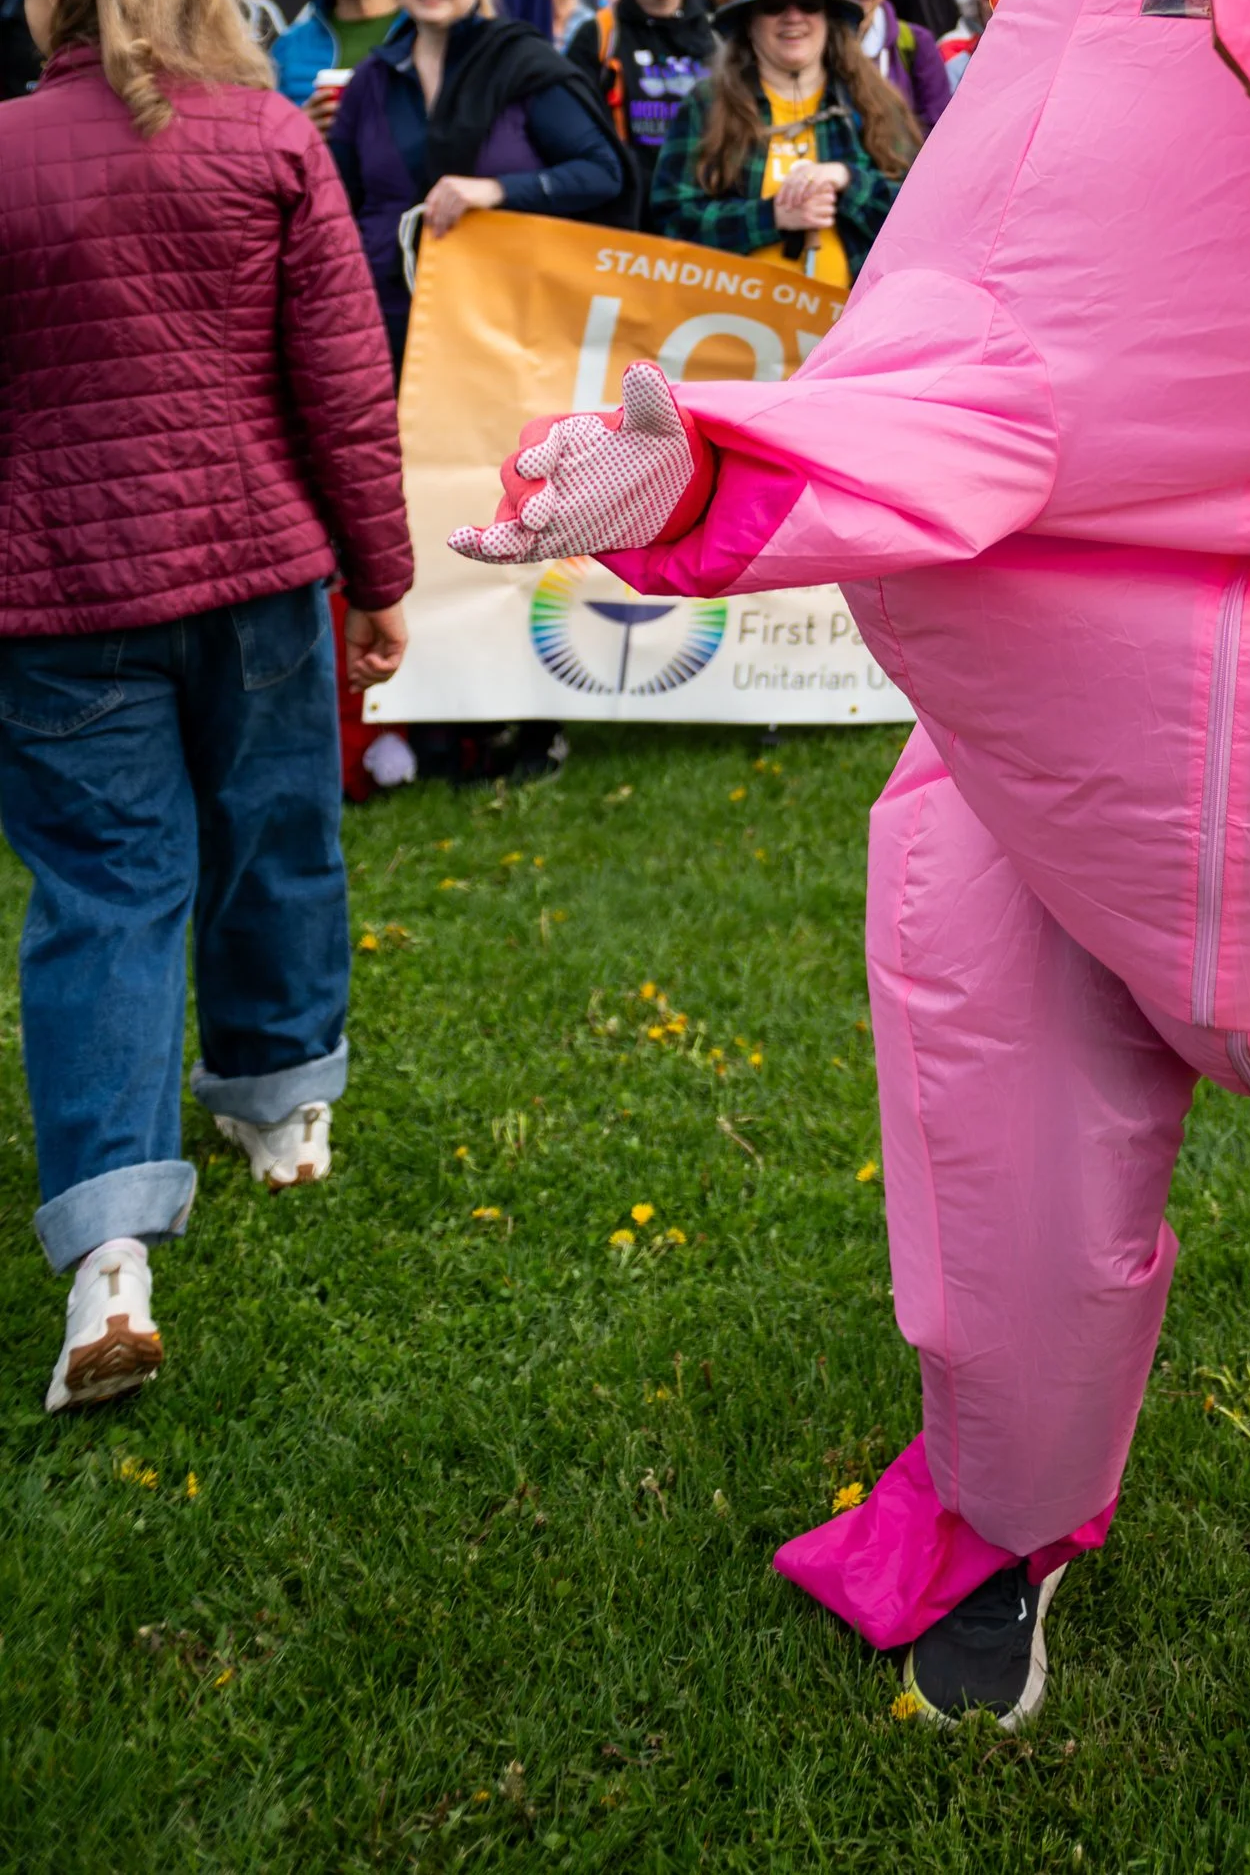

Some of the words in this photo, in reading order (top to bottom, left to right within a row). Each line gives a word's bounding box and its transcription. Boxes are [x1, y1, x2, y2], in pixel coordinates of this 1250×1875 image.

[595, 248, 763, 300] STANDING
[772, 284, 821, 315] ON
[738, 610, 816, 646] First
[732, 663, 857, 691] Unitarian
